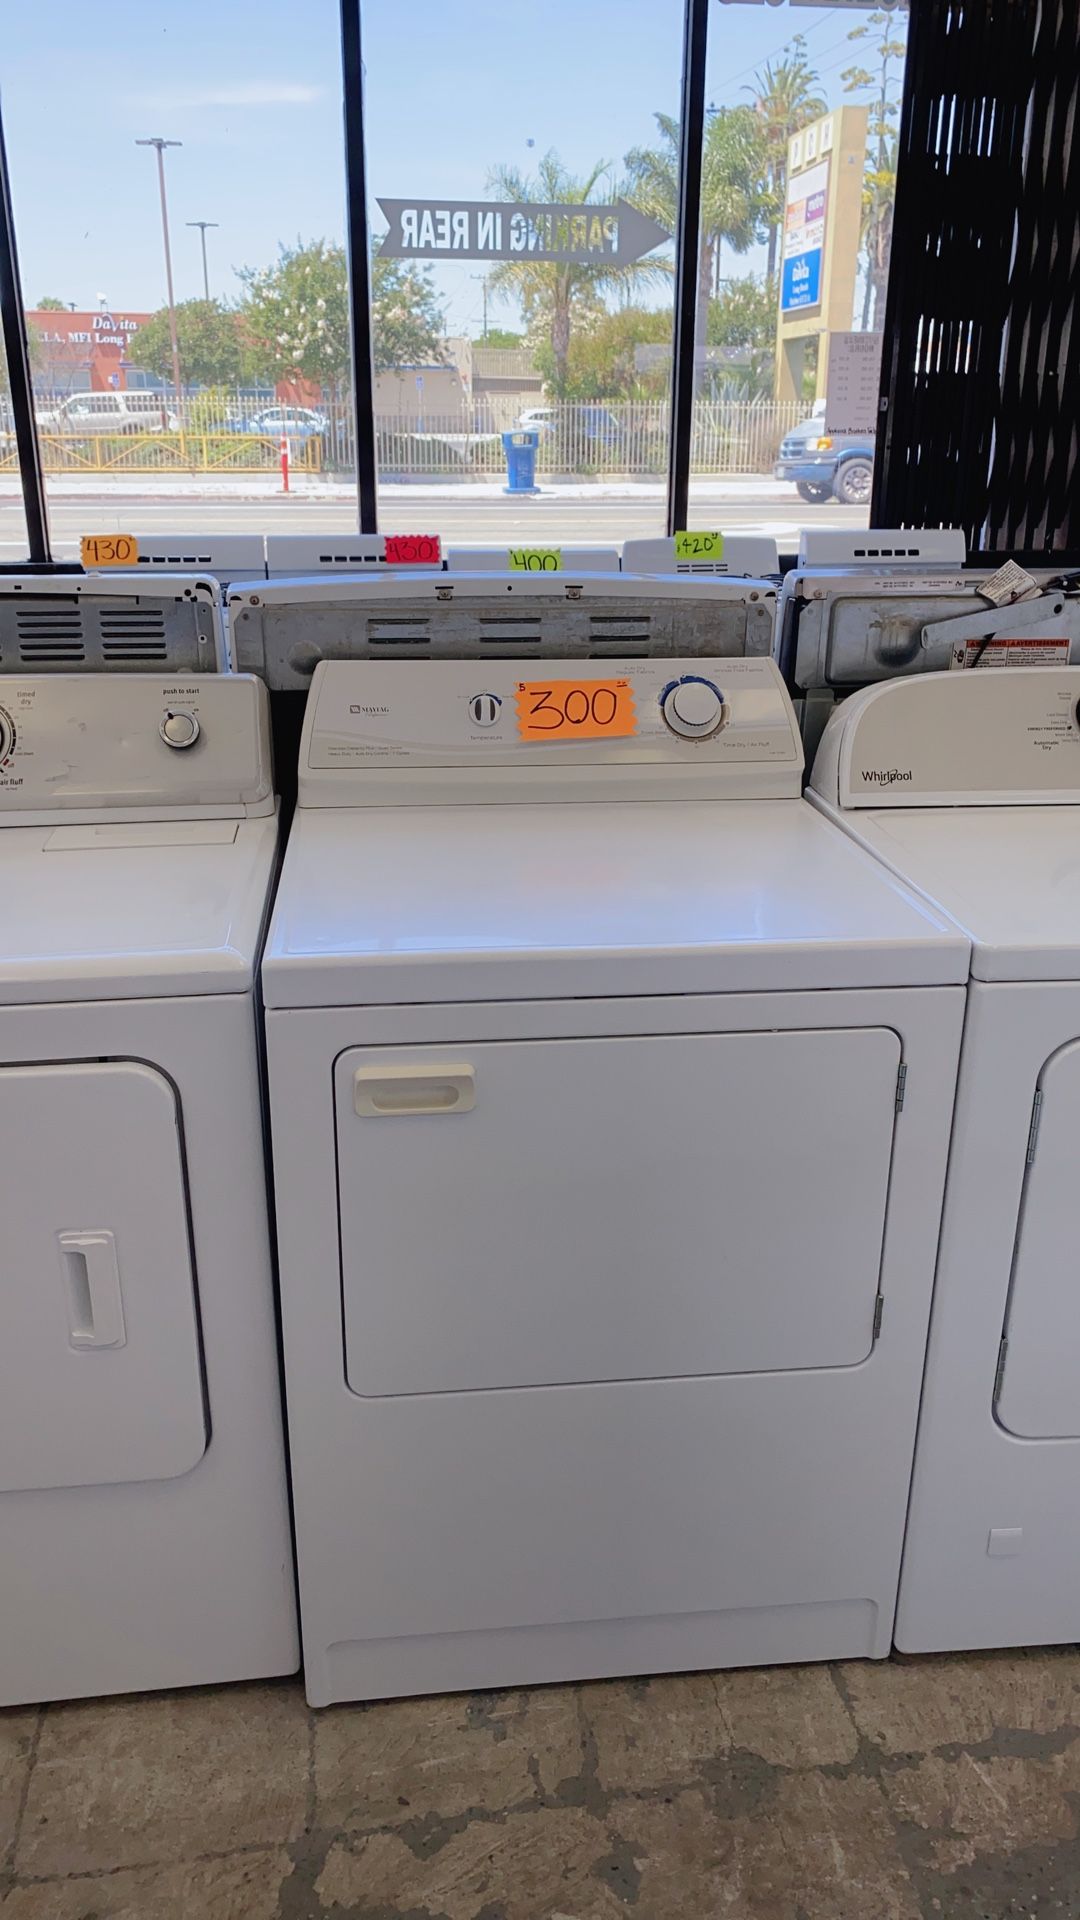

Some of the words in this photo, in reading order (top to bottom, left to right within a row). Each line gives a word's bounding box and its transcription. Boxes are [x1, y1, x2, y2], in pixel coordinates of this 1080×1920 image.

[92, 313, 138, 332] DaVita
[95, 333, 124, 346] Long
[388, 541, 434, 561] 430
[17, 690, 36, 698] timed
[0, 778, 9, 786] air
[861, 768, 913, 785] Whirlpool
